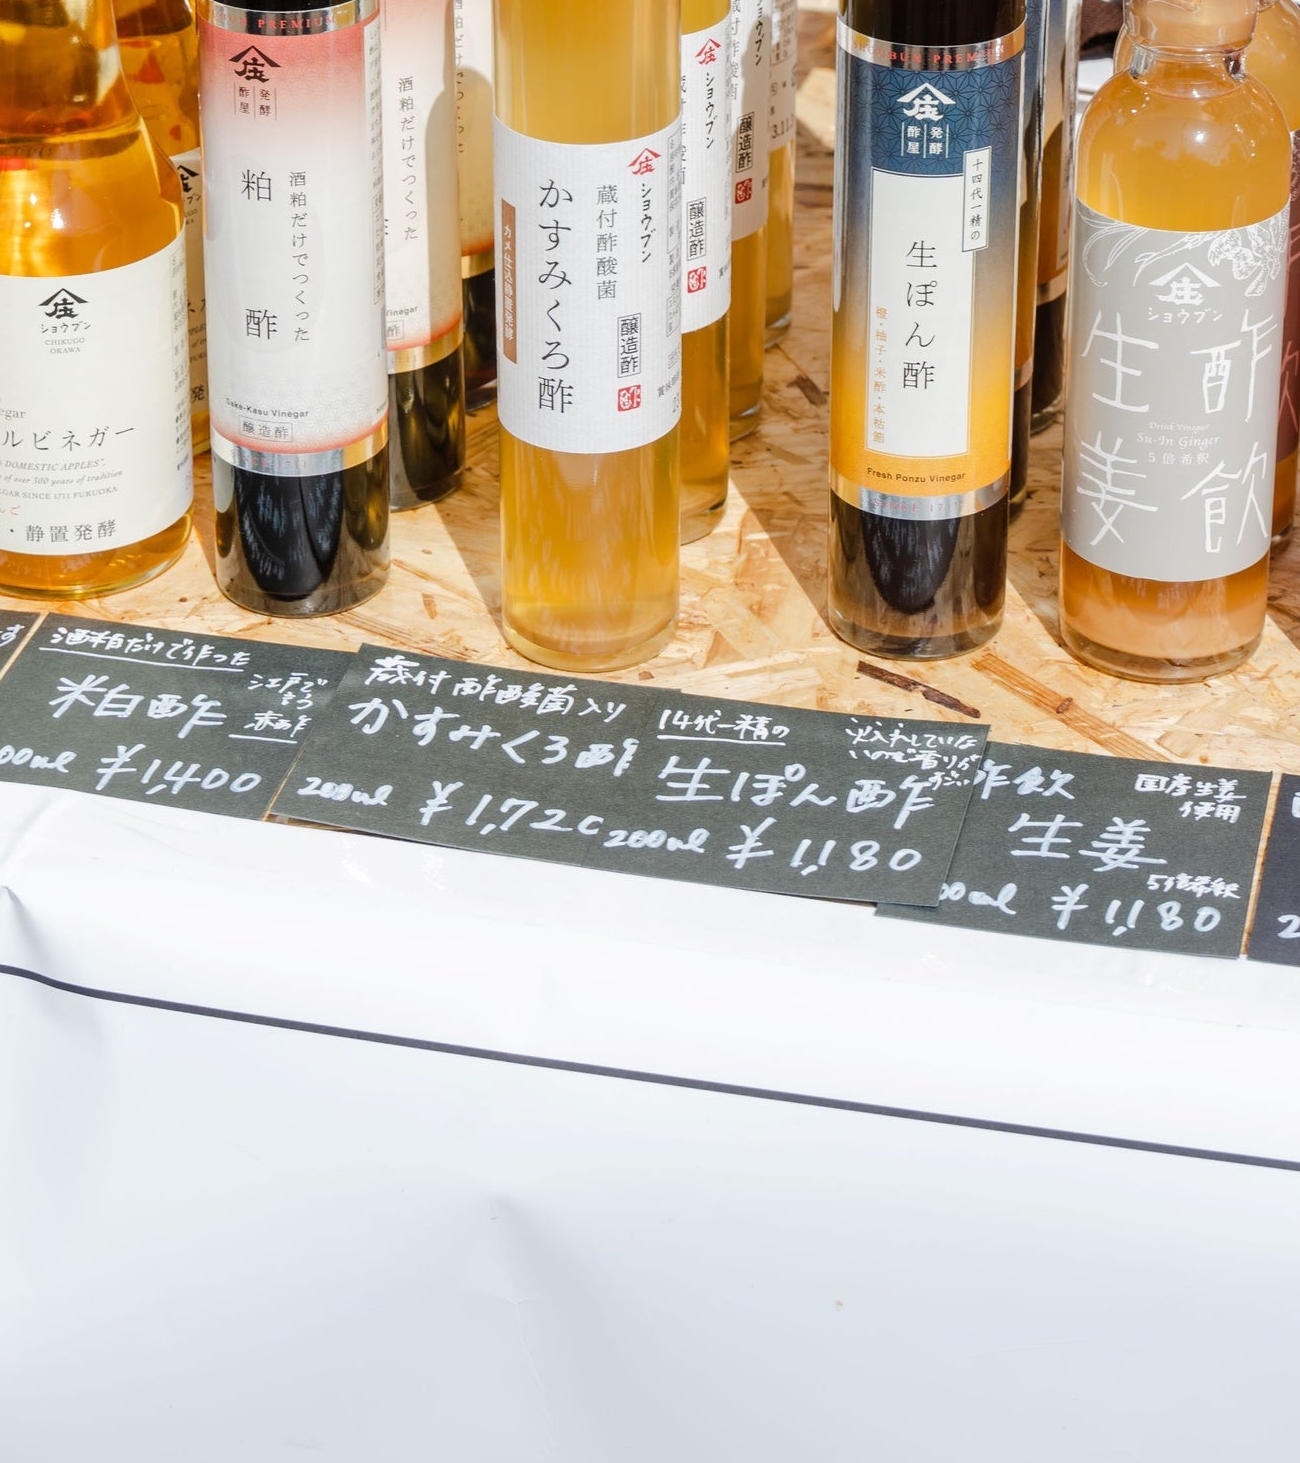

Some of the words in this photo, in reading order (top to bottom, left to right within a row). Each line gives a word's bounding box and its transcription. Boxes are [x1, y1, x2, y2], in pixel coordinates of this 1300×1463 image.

[257, 15, 337, 30] PREMIUM
[238, 86, 250, 115] 酢屋
[259, 88, 270, 117] 発酵
[704, 72, 718, 150] ショウブン
[397, 74, 419, 242] 酒粕だけでつくった
[737, 115, 753, 171] 醸造酢
[907, 125, 921, 155] 酢屋
[928, 124, 944, 156] 発酵
[640, 182, 658, 265] ショウブン
[970, 157, 985, 241] 十四代一精の
[288, 170, 310, 343] 酒粕だけでつくった
[595, 184, 619, 301] 蔵付酢酸菌
[687, 201, 707, 260] 醸造酢
[537, 178, 574, 415] かすみくろ酢
[902, 239, 939, 391] 生ぽん酢
[1147, 306, 1223, 325] ショウブン
[40, 321, 91, 334] ショウブン
[44, 338, 86, 346] CHIKUGO
[49, 347, 81, 355] OKAWA
[619, 316, 640, 375] 醸造酢
[225, 397, 269, 418] Sake-Kasu
[271, 407, 309, 421] Vinegar
[241, 420, 289, 440] 醸造酢
[1076, 309, 1160, 547] 生姜
[1181, 308, 1279, 554] 酢飲
[1136, 431, 1175, 448] Su-In
[1178, 434, 1222, 451] Ginger
[866, 467, 894, 482] Fresh
[895, 473, 926, 484] Ponzu
[929, 472, 966, 485] Vinegar
[49, 626, 252, 668] 酒粕だけで作った
[49, 673, 228, 740] 粕酢
[349, 696, 640, 778] かすみくろ酢
[95, 742, 263, 796] ¥1,400
[656, 755, 936, 830] 生ぽん酢
[1134, 773, 1247, 803] 国産生姜
[1178, 800, 1242, 824] 使用
[603, 828, 711, 854] 200ml
[725, 816, 923, 876] ¥1,180
[1007, 812, 1169, 873] 生姜
[940, 881, 1018, 915] 00ml
[1051, 882, 1222, 937] ¥1,180
